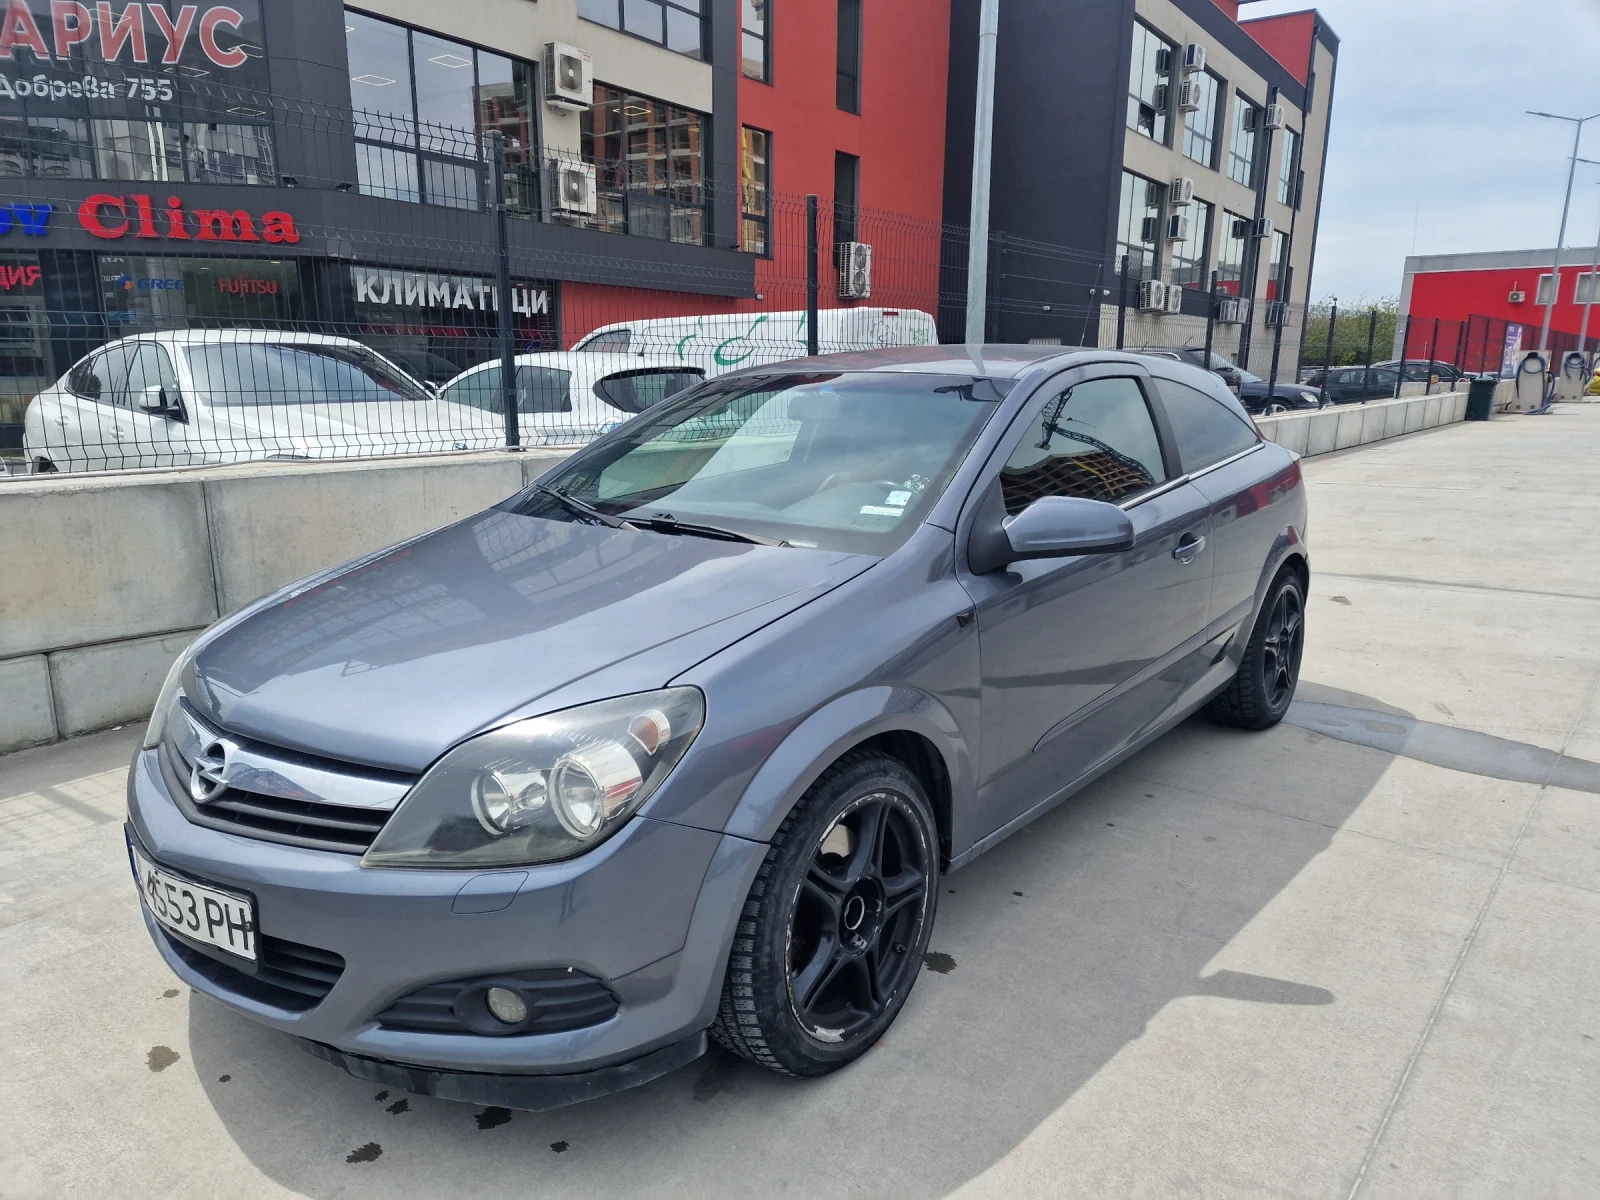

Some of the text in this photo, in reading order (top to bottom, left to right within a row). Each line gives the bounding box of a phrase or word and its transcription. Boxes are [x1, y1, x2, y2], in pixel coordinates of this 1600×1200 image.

[124, 79, 173, 101] 755
[78, 193, 299, 243] Clima
[219, 279, 278, 297] FUJITSU
